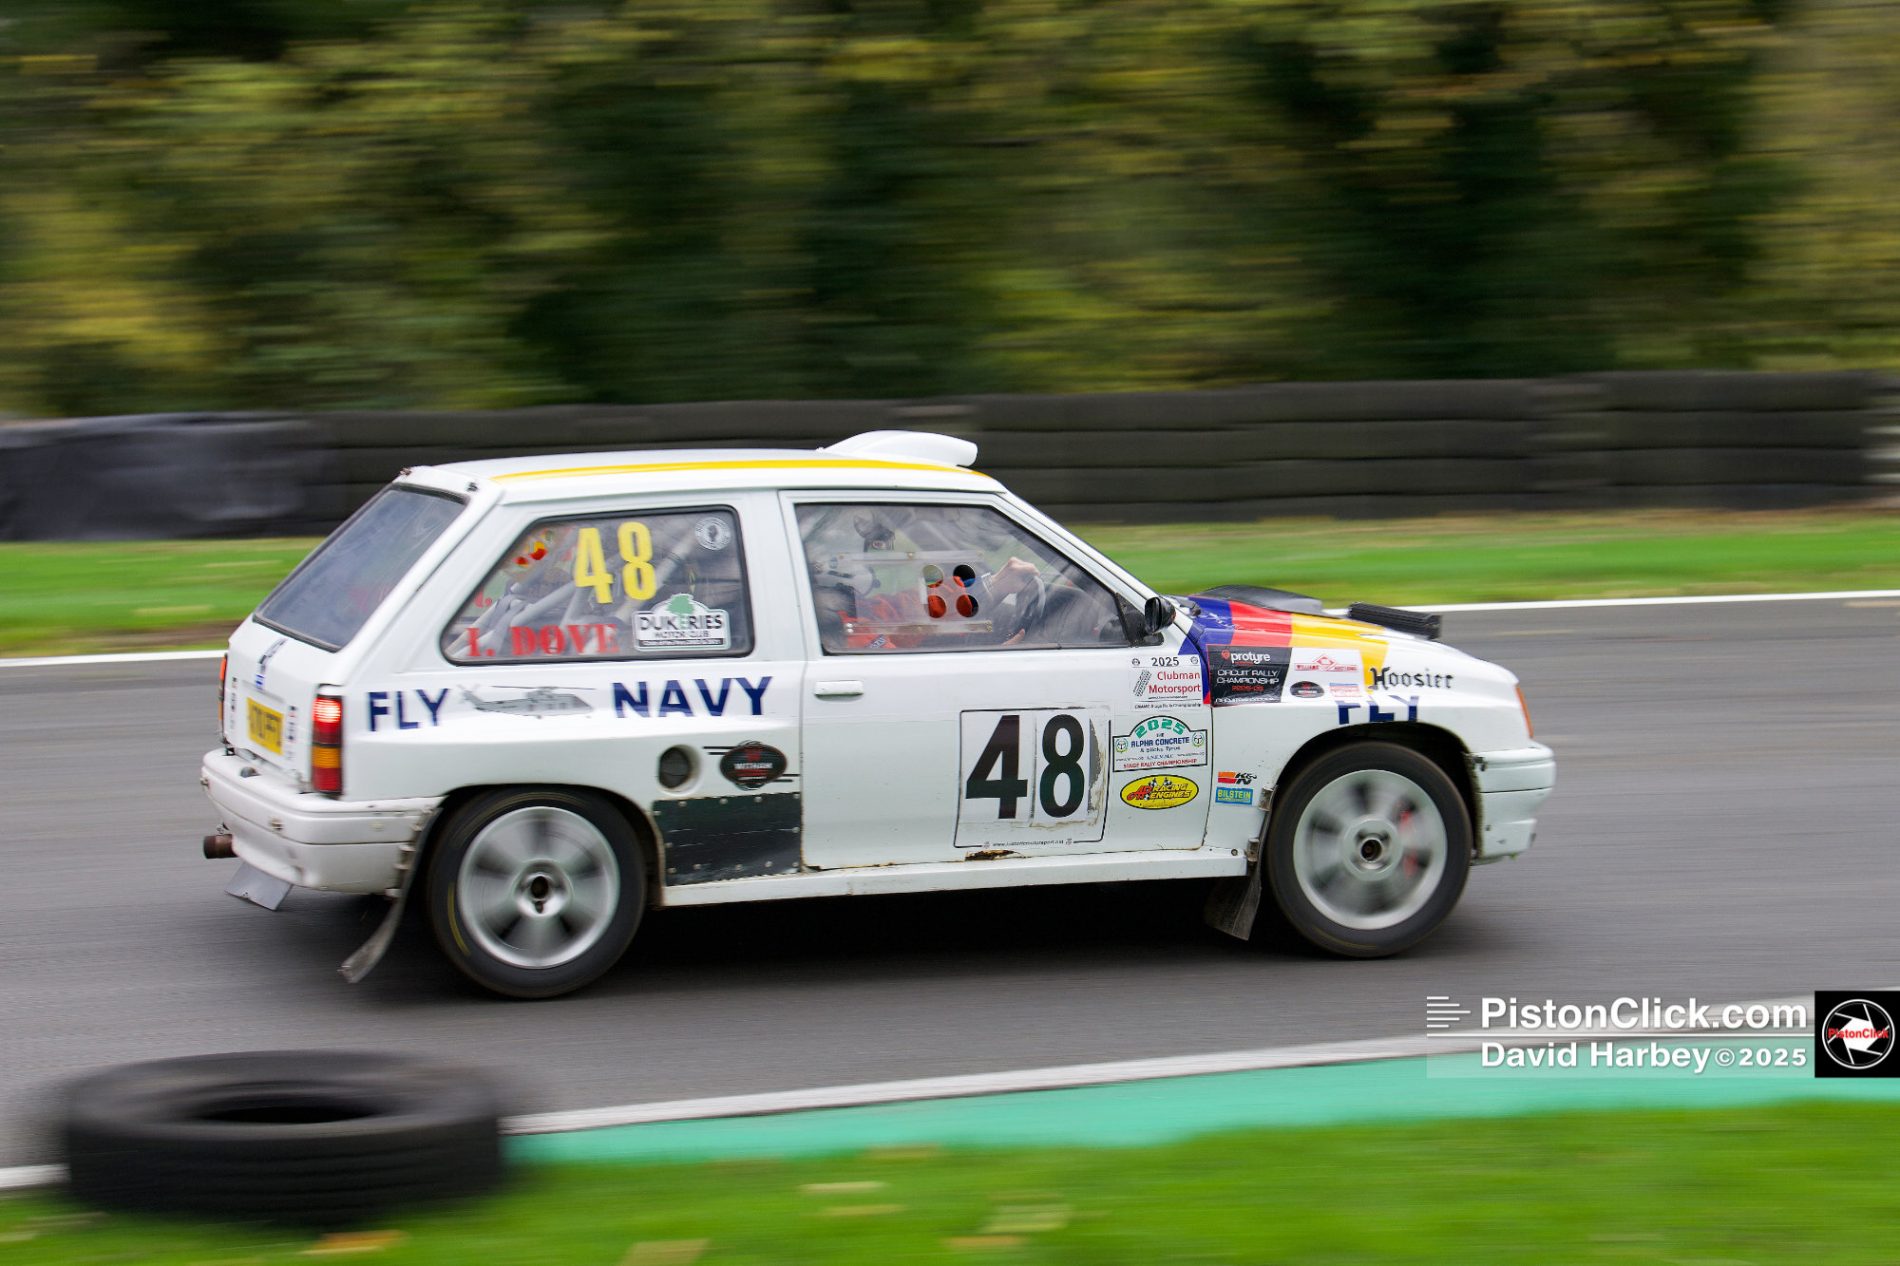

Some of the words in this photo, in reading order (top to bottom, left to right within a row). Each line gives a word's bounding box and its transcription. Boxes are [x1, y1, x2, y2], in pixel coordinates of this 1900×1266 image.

[574, 521, 657, 604] 48
[640, 615, 723, 630] DUKERIES
[511, 624, 619, 657] DOVE
[1151, 656, 1180, 667] 2025
[1231, 651, 1271, 664] protyre
[1157, 670, 1200, 680] Clubman
[1216, 677, 1280, 685] CHAMPIONSHIP
[1369, 666, 1454, 690] Hoosier
[1148, 684, 1201, 695] Motorsport
[368, 688, 449, 732] FLY
[612, 676, 772, 719] NAVY
[1134, 718, 1186, 739] 2025
[1131, 739, 1153, 748] ALPHA
[1155, 737, 1190, 746] CONCRETE
[965, 714, 1085, 819] 48
[1150, 790, 1192, 799] ENGINES
[1217, 789, 1251, 799] BILSTEIN
